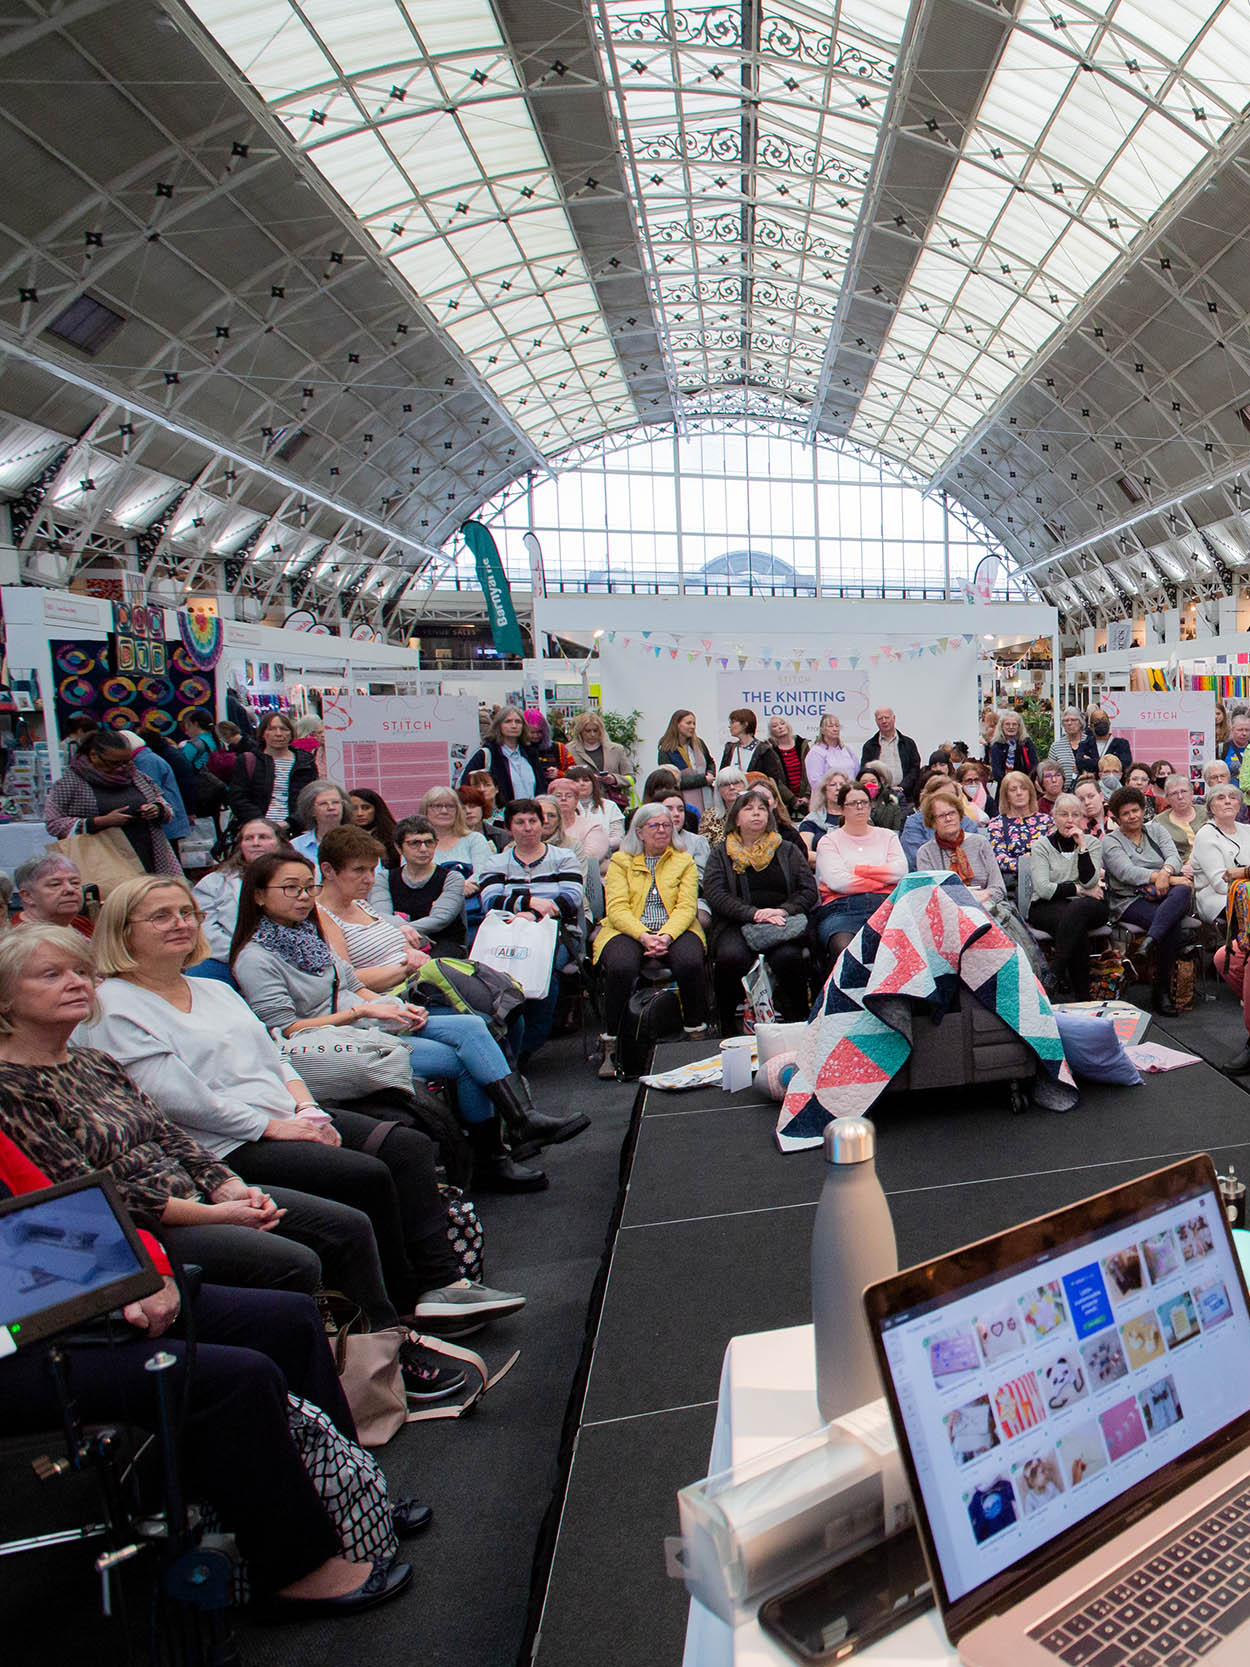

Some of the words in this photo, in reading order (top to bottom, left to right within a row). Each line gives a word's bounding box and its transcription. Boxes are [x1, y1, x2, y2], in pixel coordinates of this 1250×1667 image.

[743, 691, 772, 703] THE
[776, 691, 846, 703] KNITTING
[764, 704, 827, 716] LOUNGE
[1140, 711, 1177, 720] STITCH
[382, 719, 432, 731] STITCH
